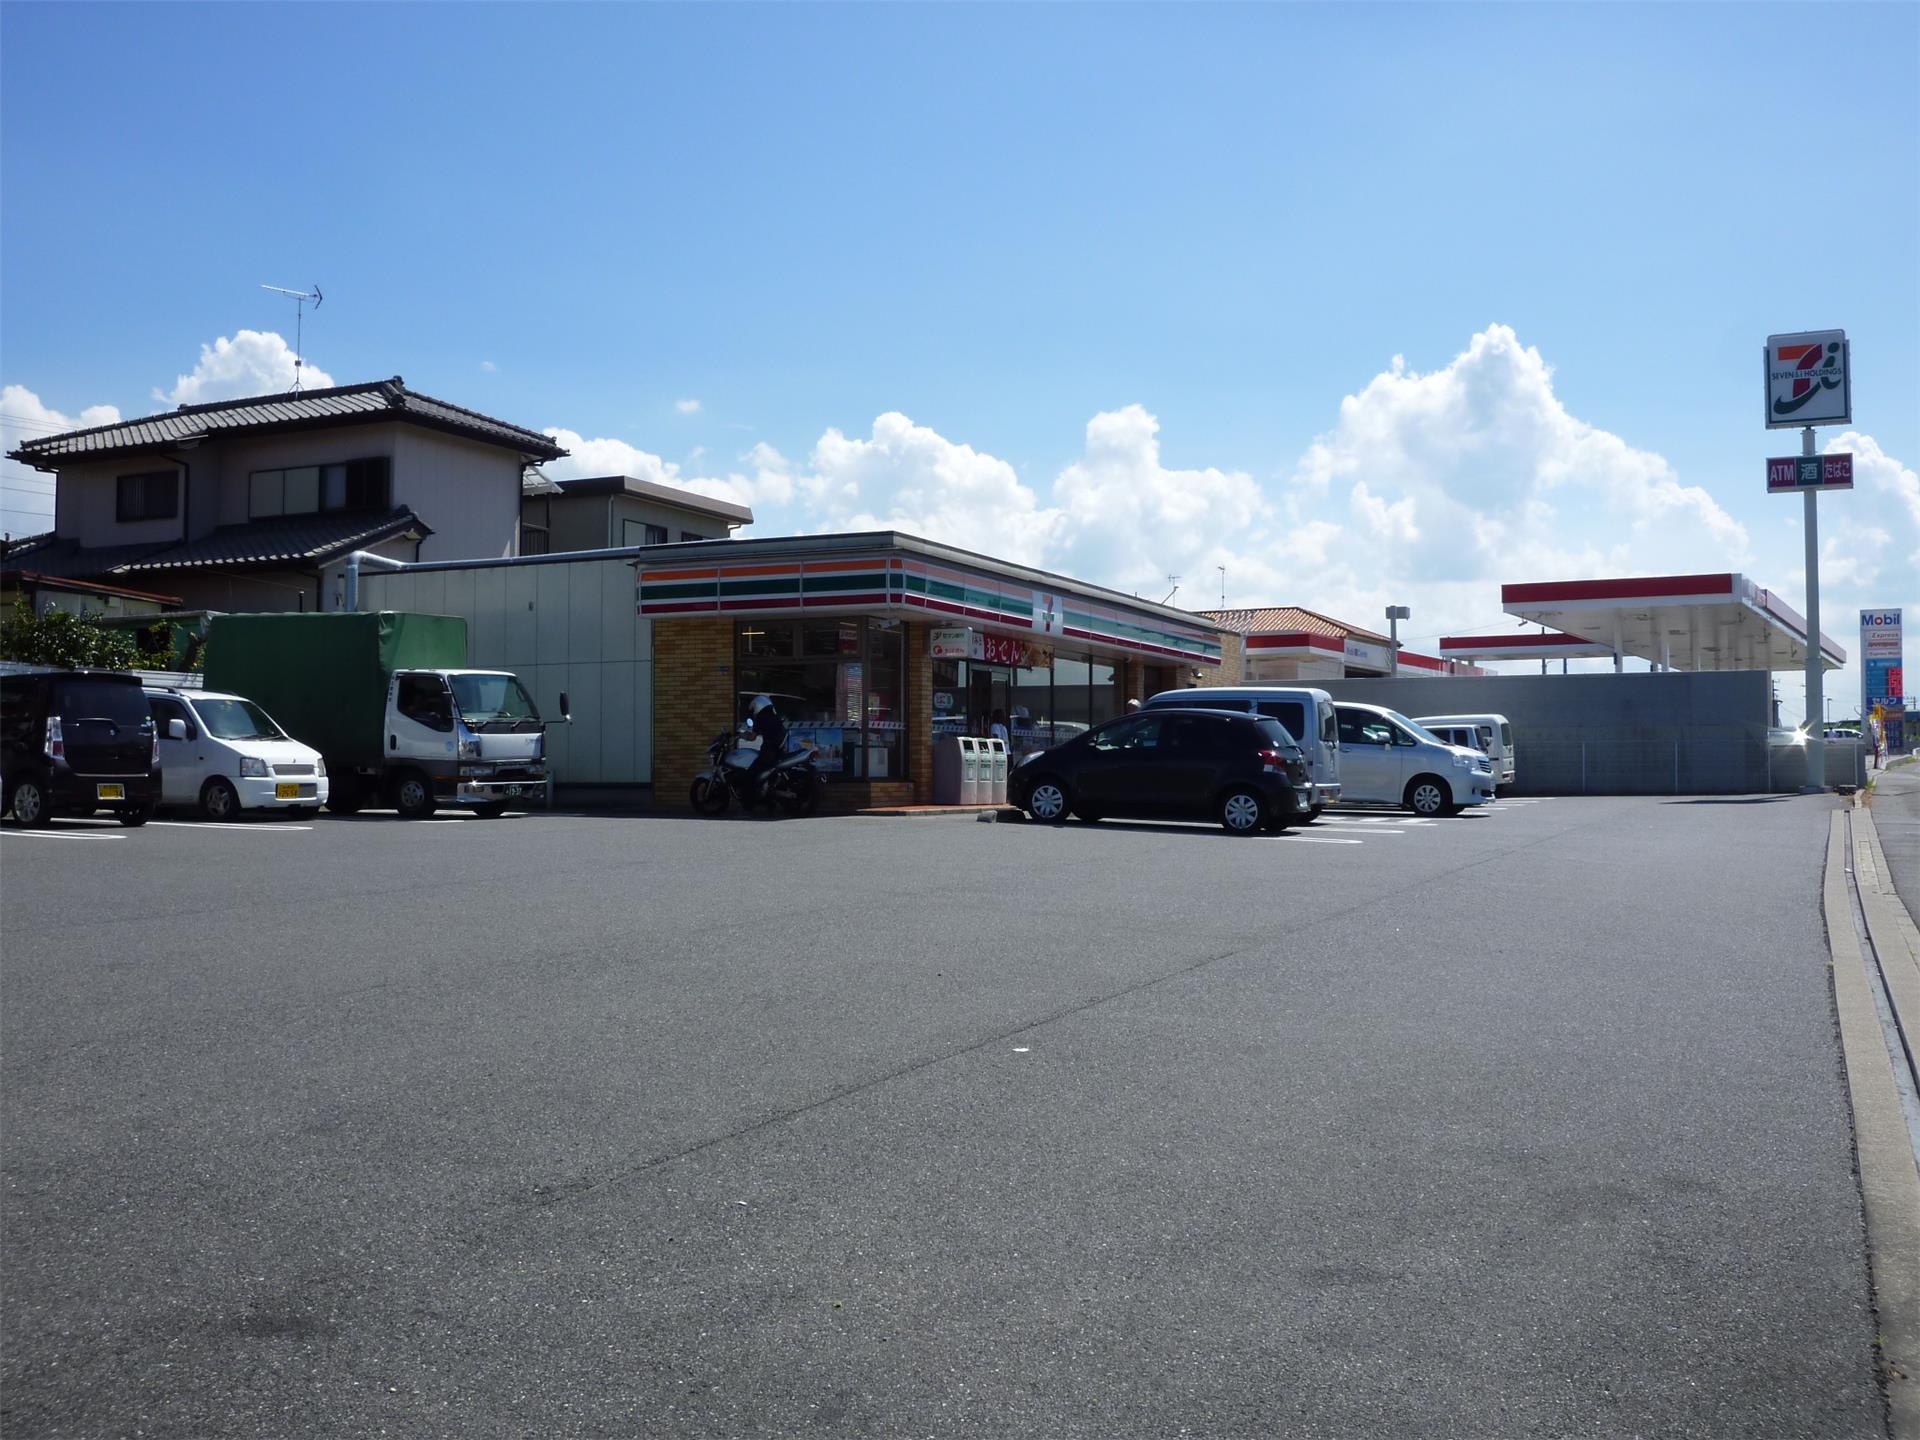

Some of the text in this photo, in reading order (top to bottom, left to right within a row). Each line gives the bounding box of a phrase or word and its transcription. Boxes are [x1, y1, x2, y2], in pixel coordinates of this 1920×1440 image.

[1772, 370, 1794, 380] SEVEN
[1804, 367, 1842, 377] HOLDINGS
[1770, 464, 1794, 481] ATM
[1801, 463, 1818, 480] 酒
[1824, 461, 1850, 479] たばこ
[1861, 613, 1900, 626] Mobil
[986, 637, 1020, 662] おでん
[1872, 697, 1897, 705] セルフ
